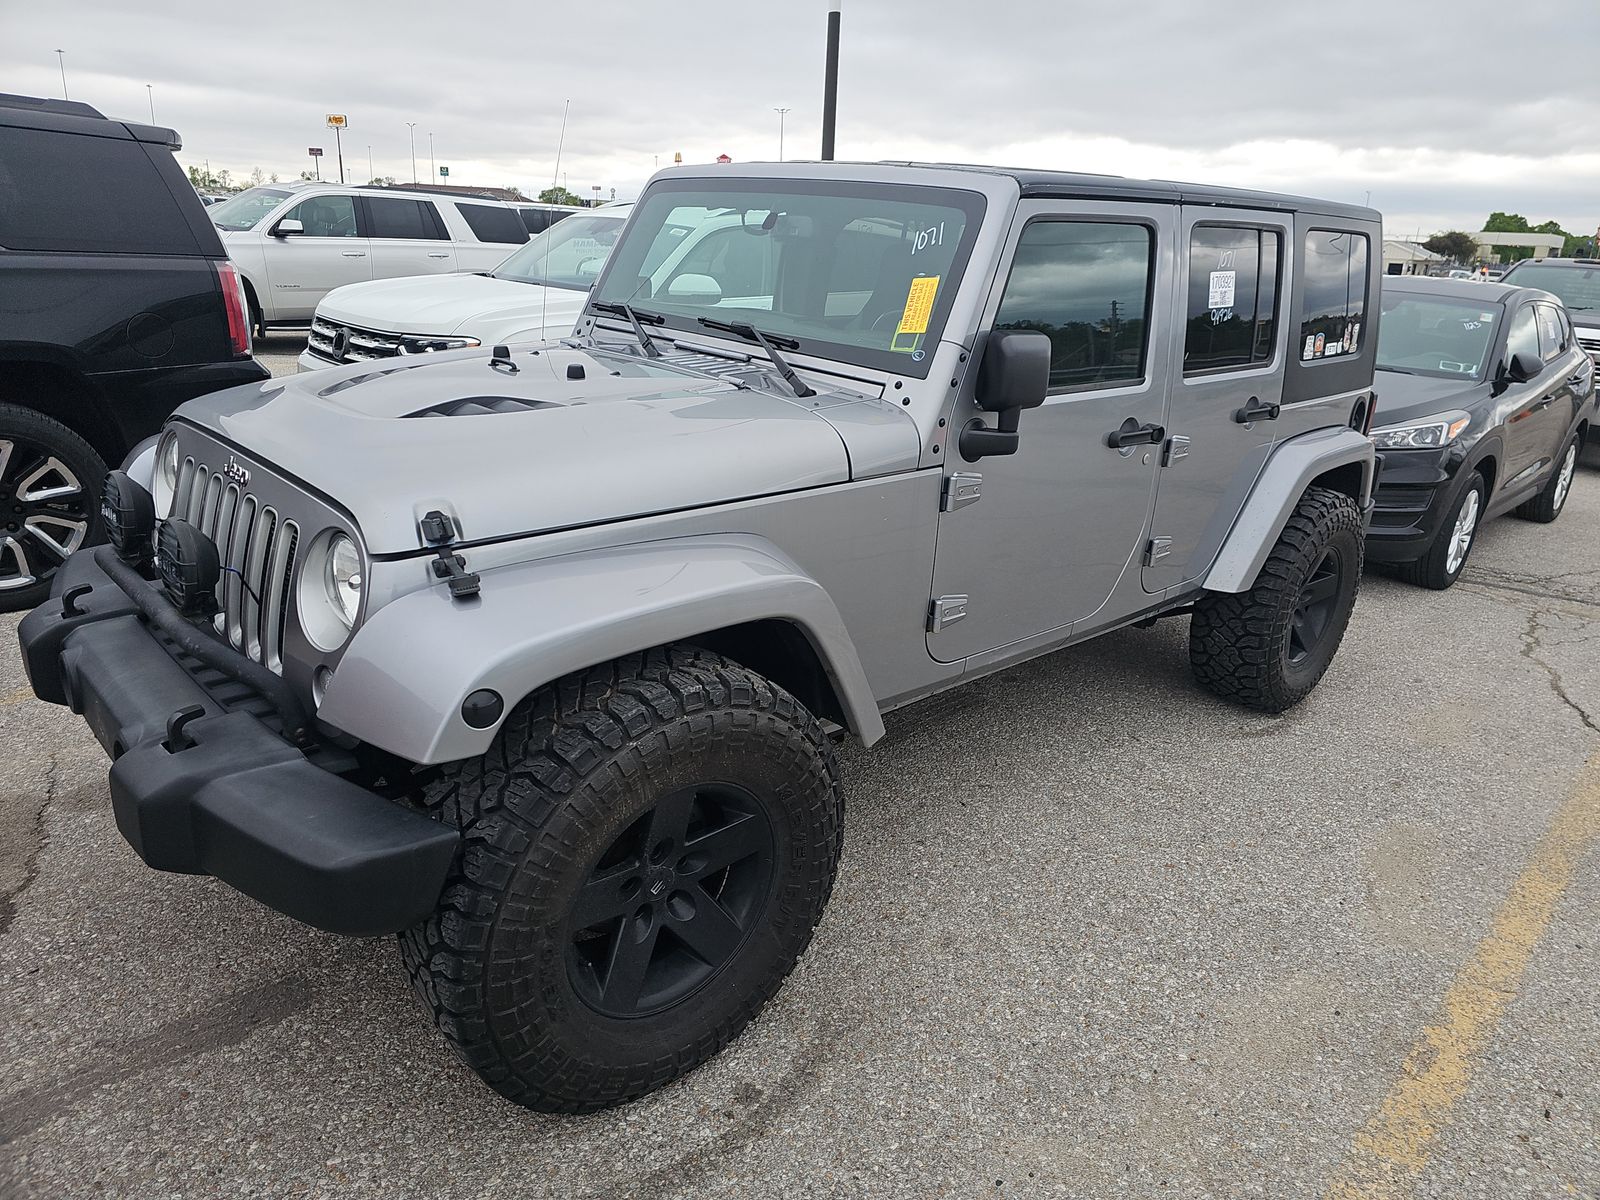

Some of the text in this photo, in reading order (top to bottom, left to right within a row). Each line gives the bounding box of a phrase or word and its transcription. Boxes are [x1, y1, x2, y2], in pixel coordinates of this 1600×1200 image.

[911, 221, 945, 255] 1071
[1217, 249, 1237, 270] 1071
[900, 281, 920, 331] THIS VEHICLE
[223, 455, 251, 491] Jeep
